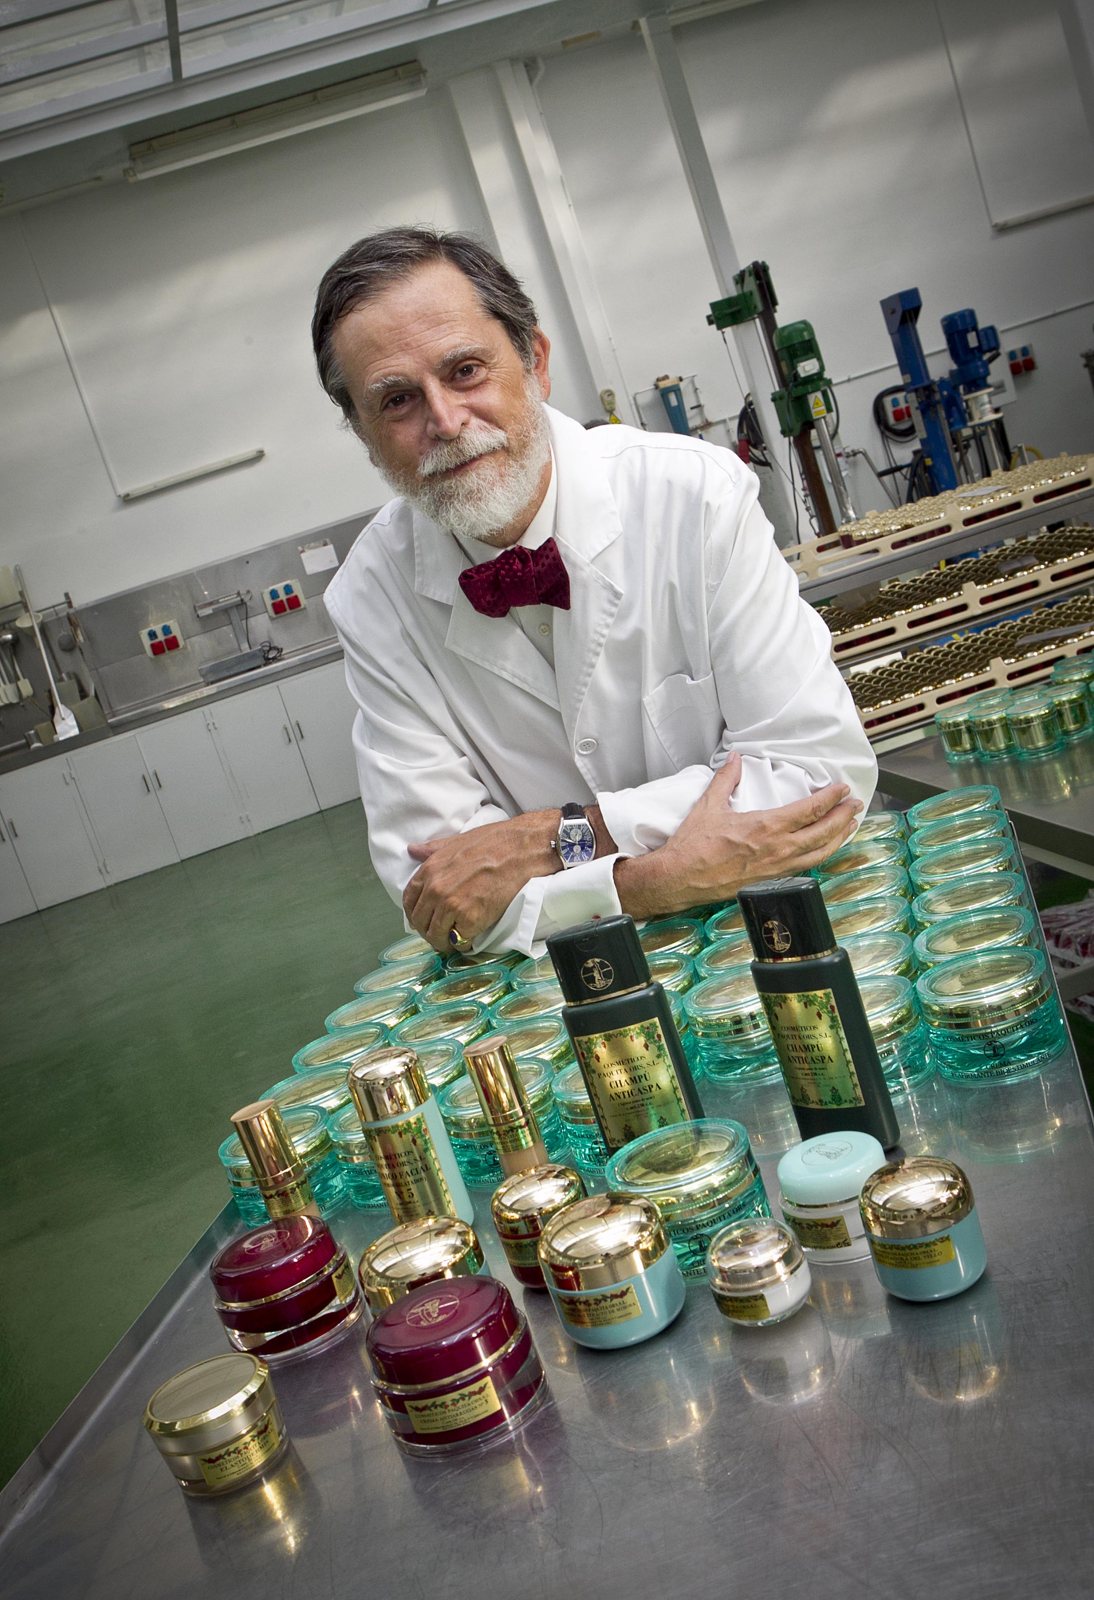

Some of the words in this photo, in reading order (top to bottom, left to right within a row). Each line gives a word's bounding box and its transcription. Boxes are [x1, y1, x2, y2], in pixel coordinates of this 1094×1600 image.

[990, 1023, 1024, 1039] PAQUITA
[787, 1041, 824, 1052] CHAMPÚ
[787, 1055, 834, 1064] ANTICASPA
[609, 1070, 651, 1089] CHAMPÚ
[609, 1083, 662, 1102] ANTICASPA
[398, 1163, 432, 1179] FACIAL
[695, 1213, 732, 1231] PAQUITA
